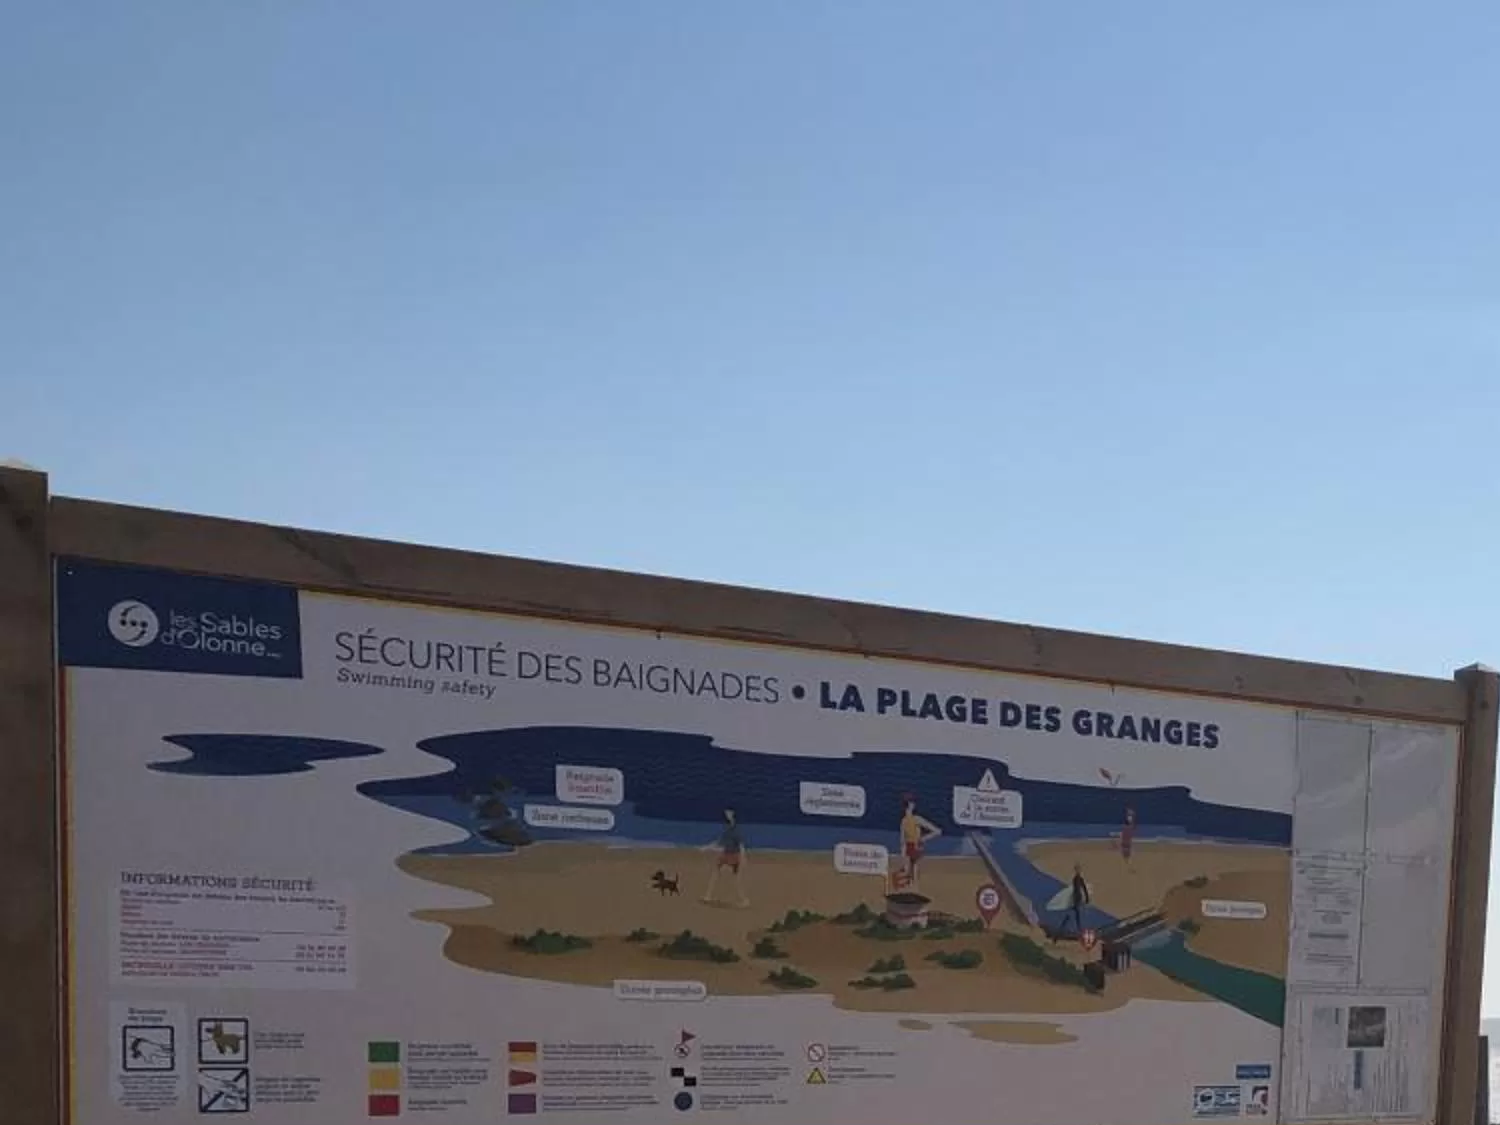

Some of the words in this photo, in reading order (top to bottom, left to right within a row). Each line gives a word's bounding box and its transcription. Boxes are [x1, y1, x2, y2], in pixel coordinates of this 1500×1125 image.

[170, 608, 198, 629] les
[199, 611, 283, 640] Sables
[335, 627, 508, 677] SÉCURITÉ
[517, 651, 583, 685] DES
[593, 659, 780, 704] BAIGNADES
[819, 681, 865, 713] LA
[876, 687, 988, 725] PLAGE
[1000, 701, 1061, 733] DES
[1071, 709, 1220, 749] GRANGES
[336, 667, 435, 694] Swimming
[441, 680, 497, 700] safety
[120, 870, 237, 889] INFORMATIONS
[241, 876, 314, 893] SÉCURITÉ
